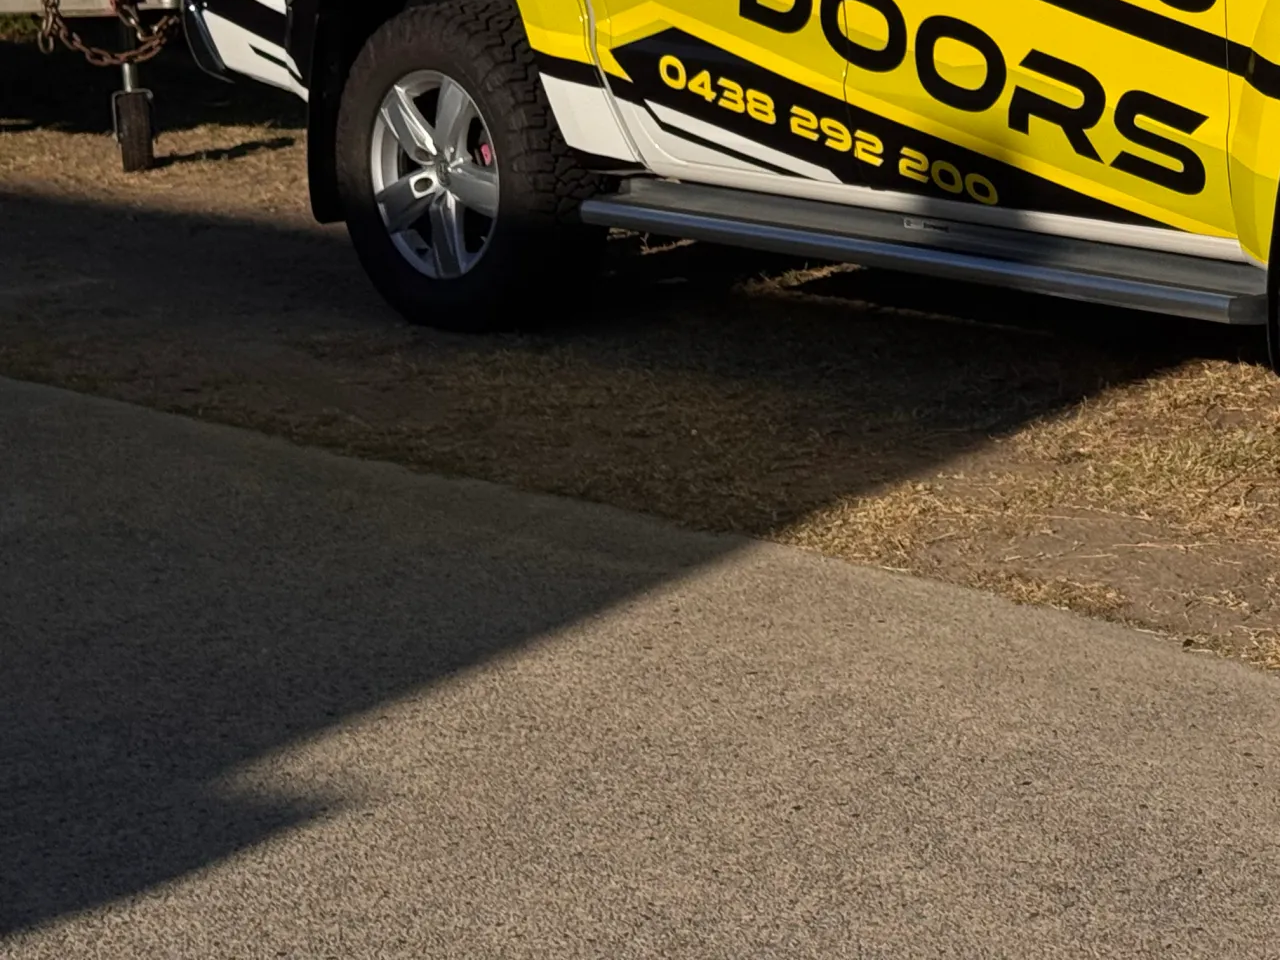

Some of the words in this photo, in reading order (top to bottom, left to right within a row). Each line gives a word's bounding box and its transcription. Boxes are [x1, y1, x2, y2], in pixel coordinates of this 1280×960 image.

[658, 53, 777, 126] 0438
[790, 106, 884, 168] 292
[898, 146, 999, 206] 200
